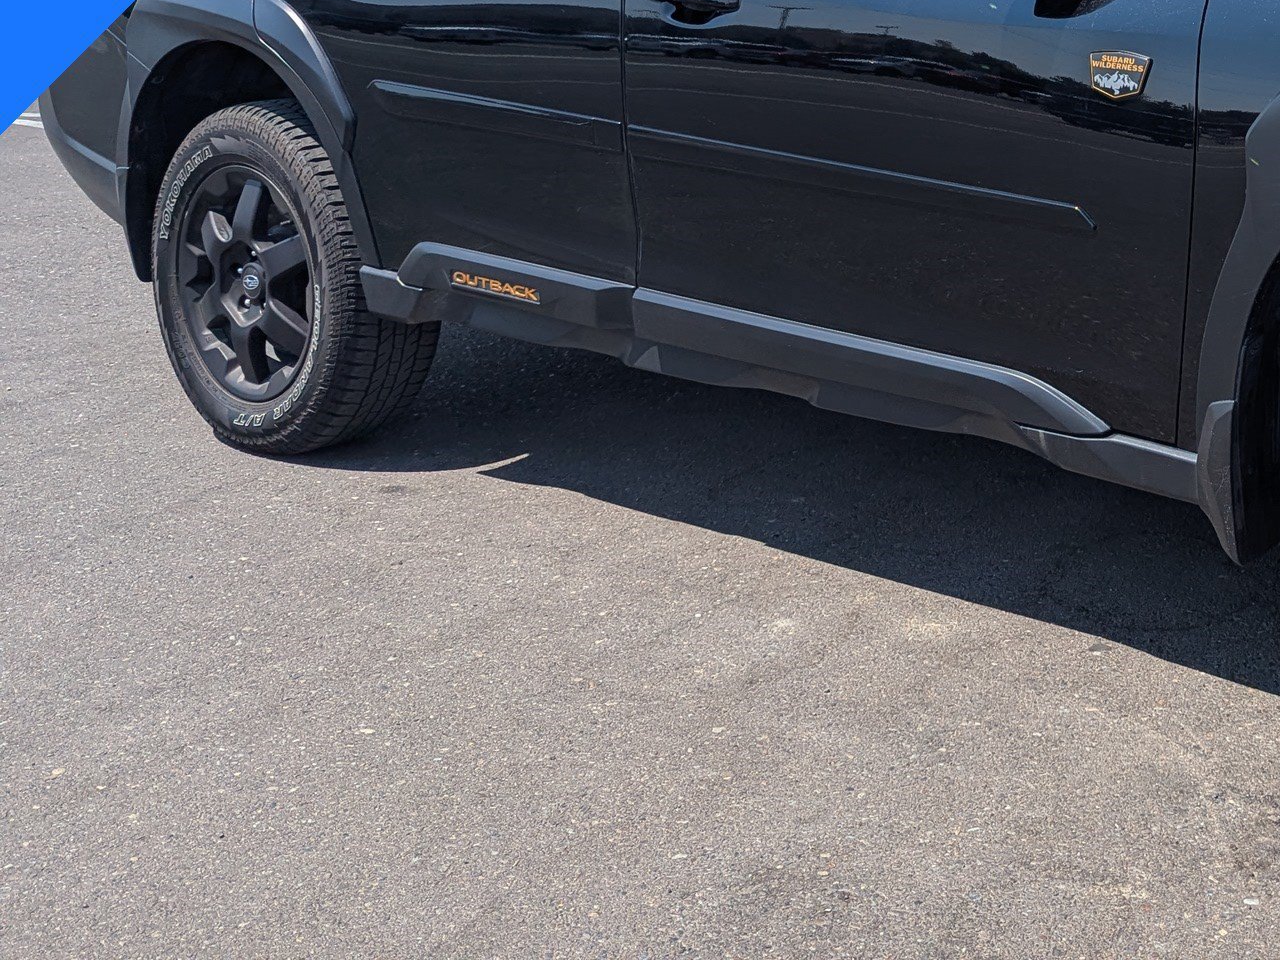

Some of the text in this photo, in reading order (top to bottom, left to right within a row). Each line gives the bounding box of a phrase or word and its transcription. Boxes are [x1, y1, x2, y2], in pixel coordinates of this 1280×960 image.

[1091, 60, 1145, 73] WILDERNESS
[1101, 54, 1136, 65] SUBARU
[159, 145, 214, 240] YOKOHAMA
[452, 271, 539, 301] OUTBACK
[233, 284, 322, 427] GEOLANDAR A/T
